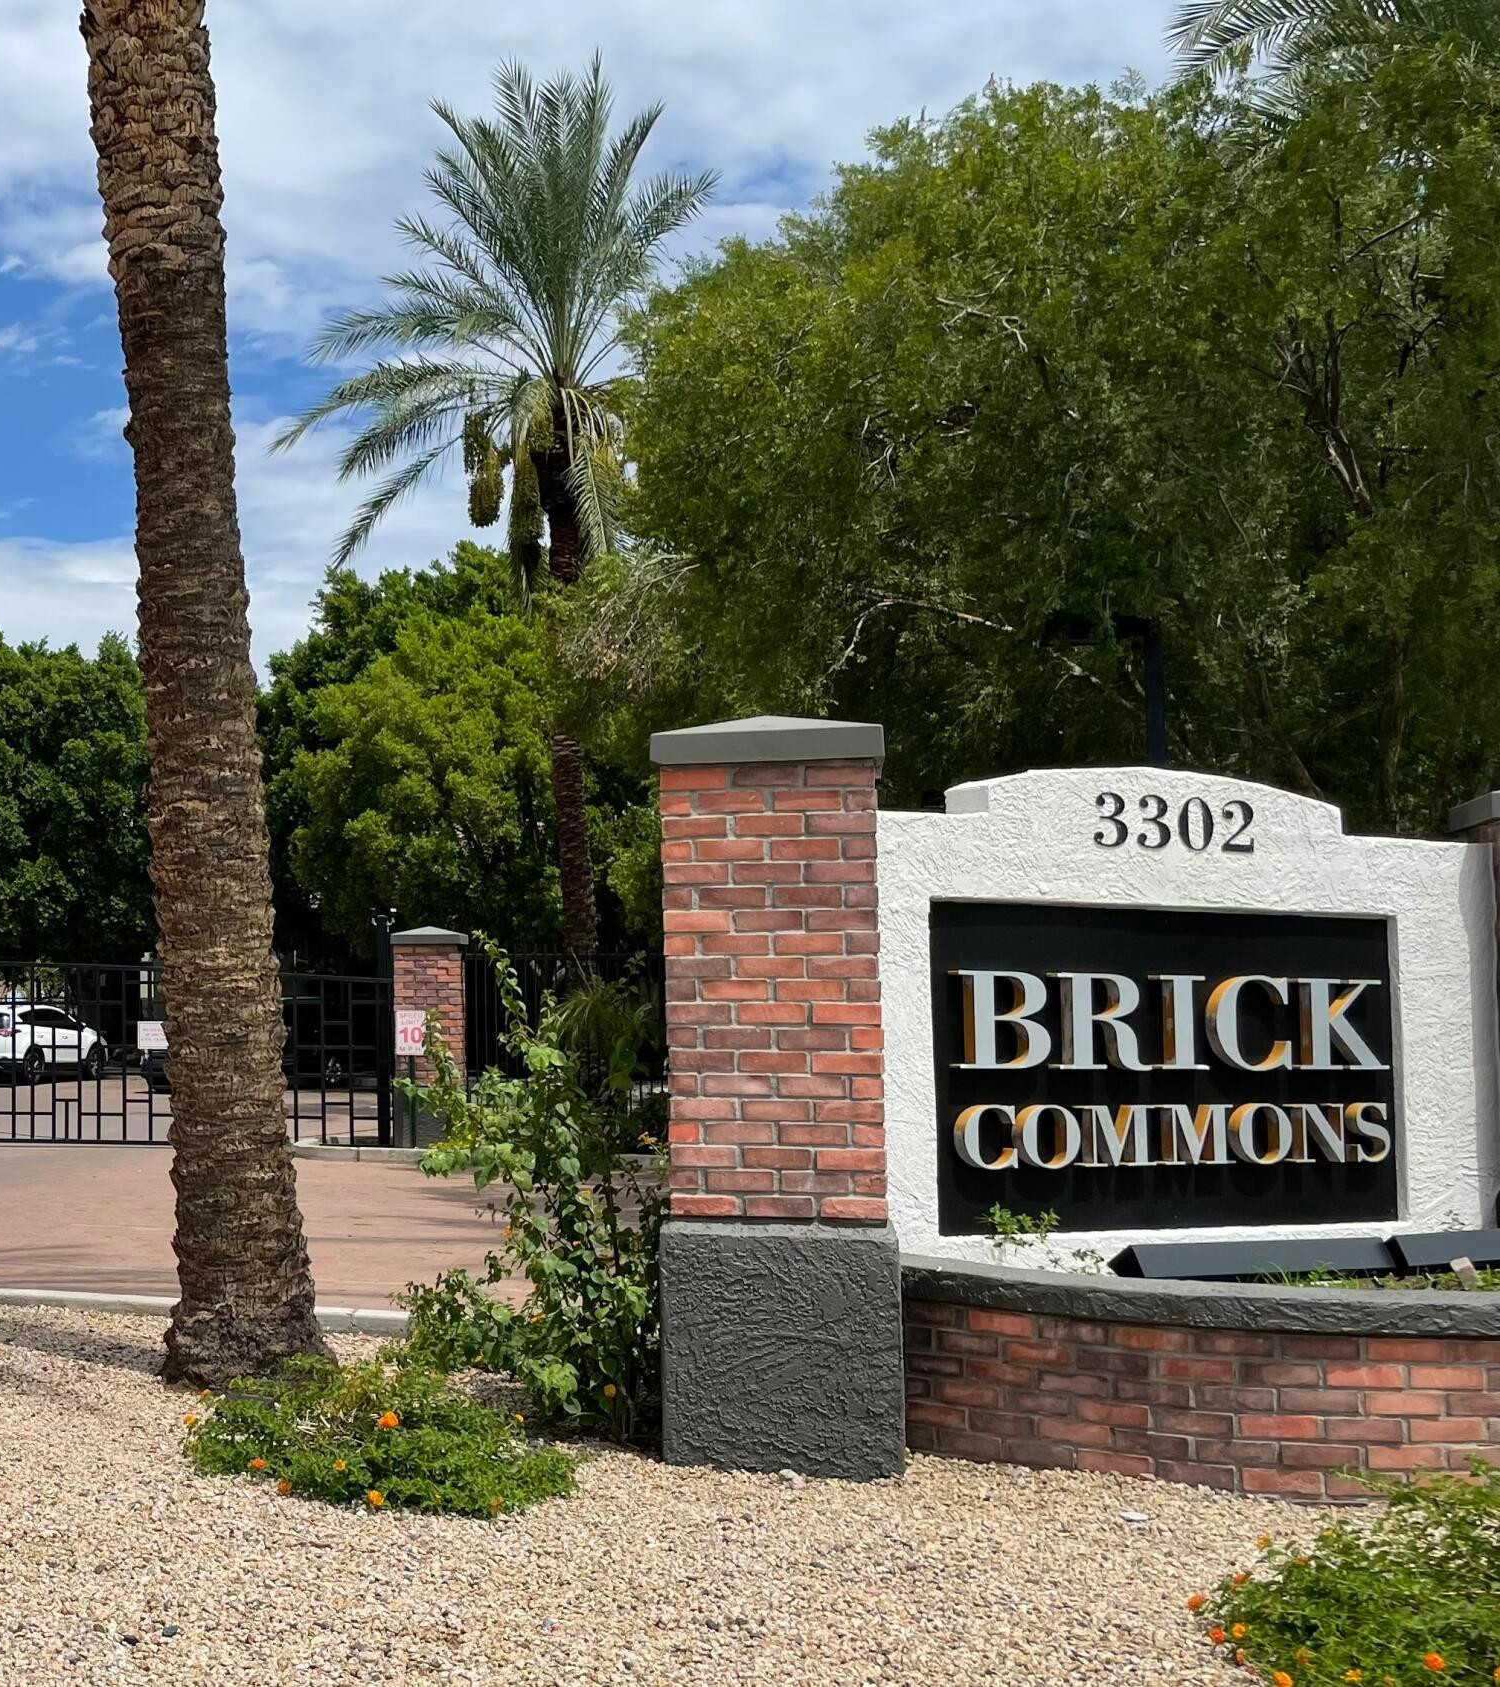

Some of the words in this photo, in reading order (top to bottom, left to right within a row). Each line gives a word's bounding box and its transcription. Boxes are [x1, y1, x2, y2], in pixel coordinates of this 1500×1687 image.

[1093, 791, 1255, 853] 3302
[399, 1026, 423, 1044] 10
[947, 969, 1390, 1072] BRICK
[954, 1101, 1392, 1169] COMMONS
